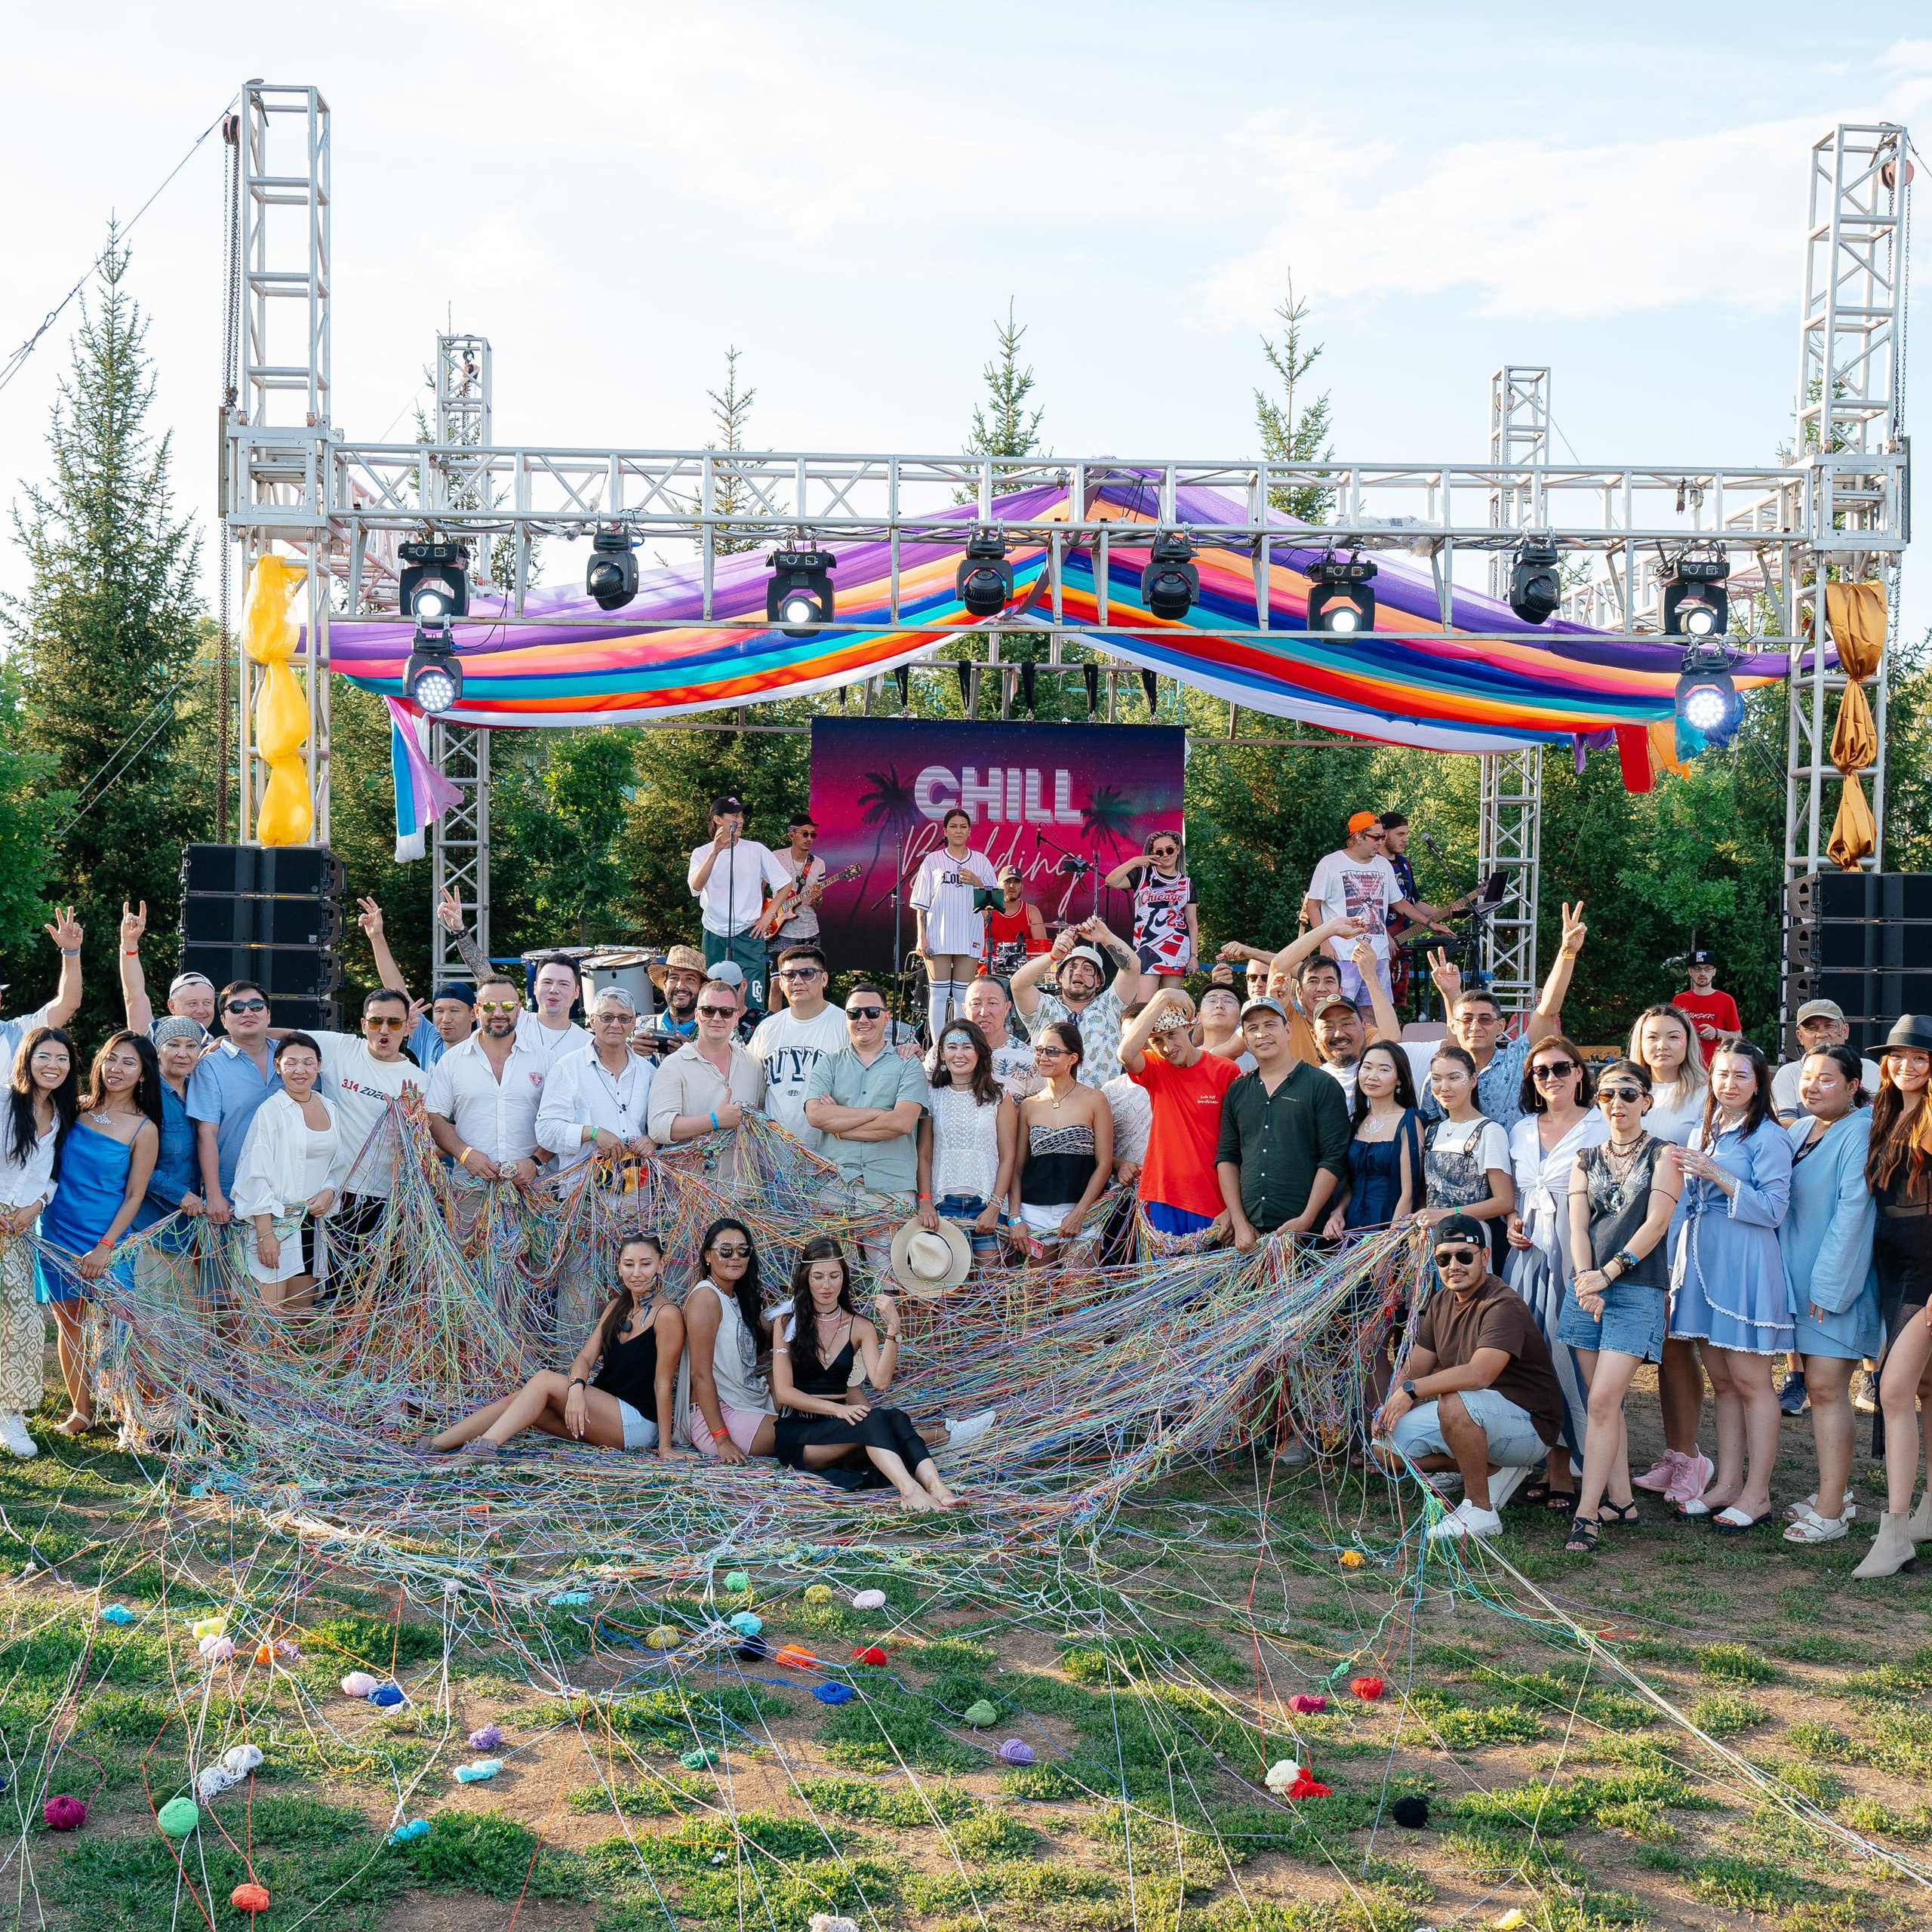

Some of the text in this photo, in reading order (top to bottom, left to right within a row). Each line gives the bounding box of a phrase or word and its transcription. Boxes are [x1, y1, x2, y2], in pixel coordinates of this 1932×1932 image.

[914, 765, 1082, 823] CHILL
[901, 822, 1093, 917] Blding
[1140, 891, 1183, 907] Chicago
[1166, 909, 1187, 929] 23
[1684, 1011, 1715, 1020] URDER
